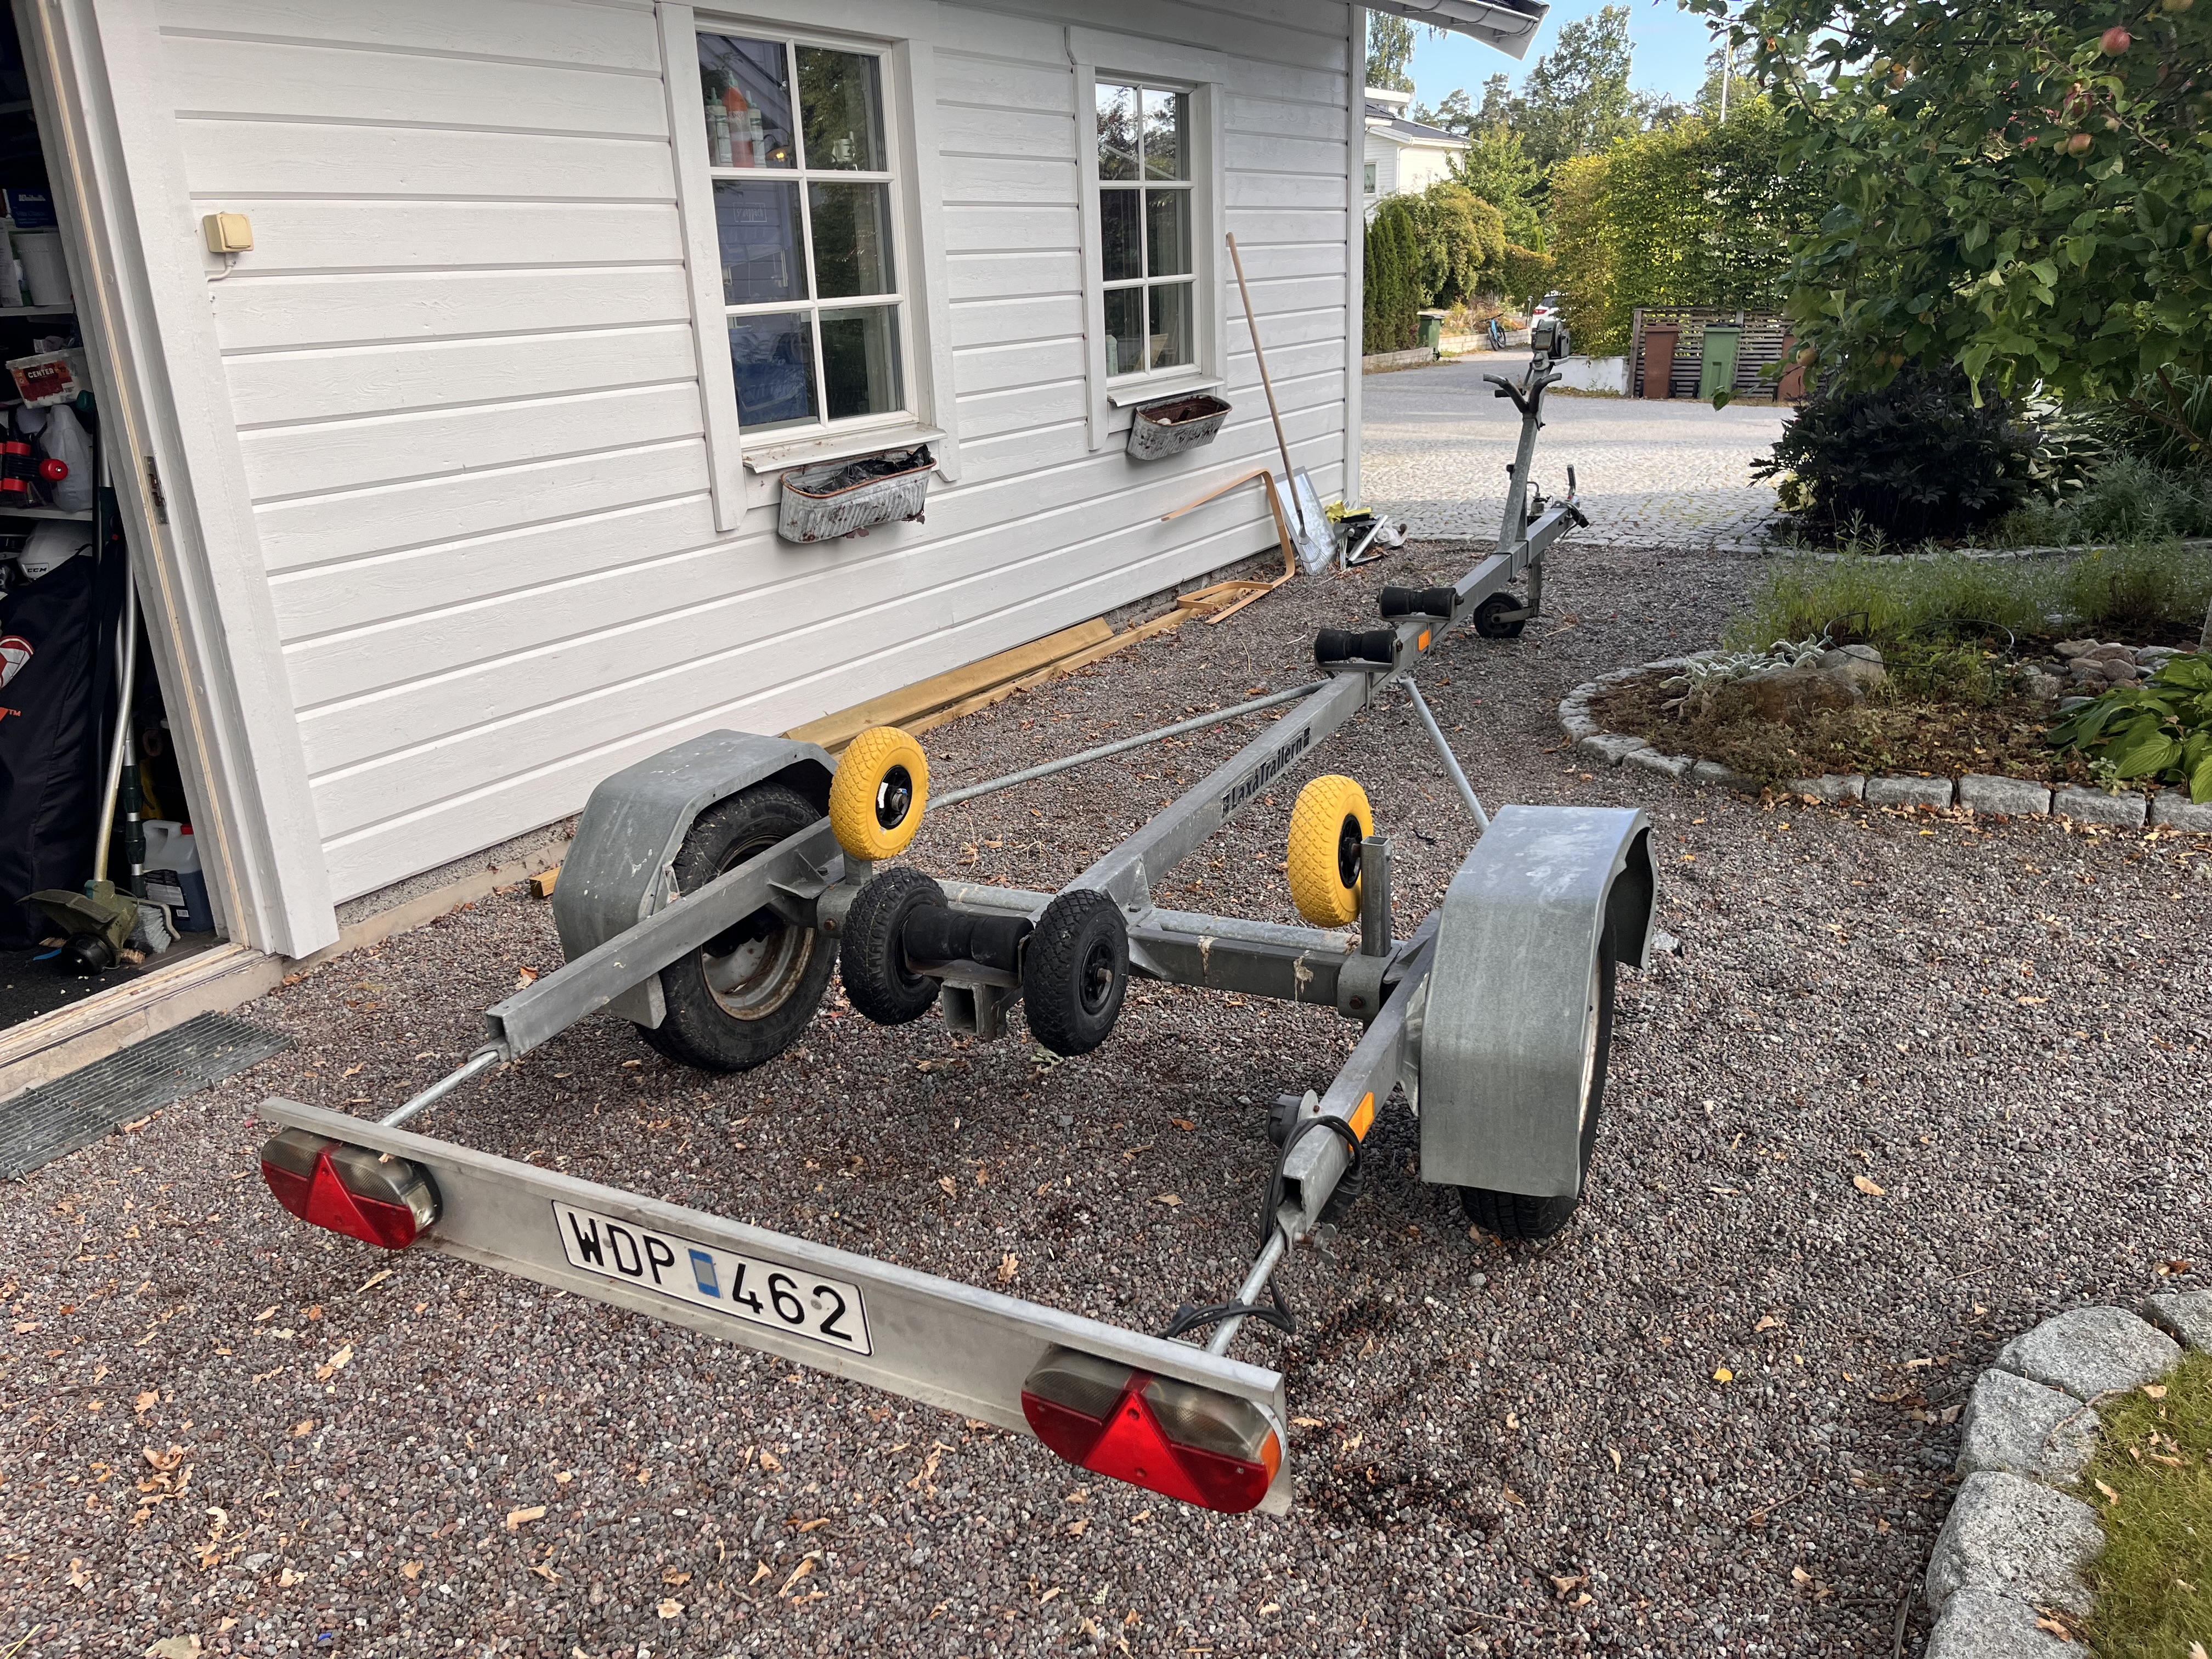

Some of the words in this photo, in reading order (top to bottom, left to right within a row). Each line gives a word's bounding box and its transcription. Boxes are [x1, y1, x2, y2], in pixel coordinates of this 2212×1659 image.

[27, 368, 54, 378] CENTER
[8, 709, 21, 717] TM
[568, 1211, 675, 1285] WDP
[731, 1261, 853, 1342] 462
